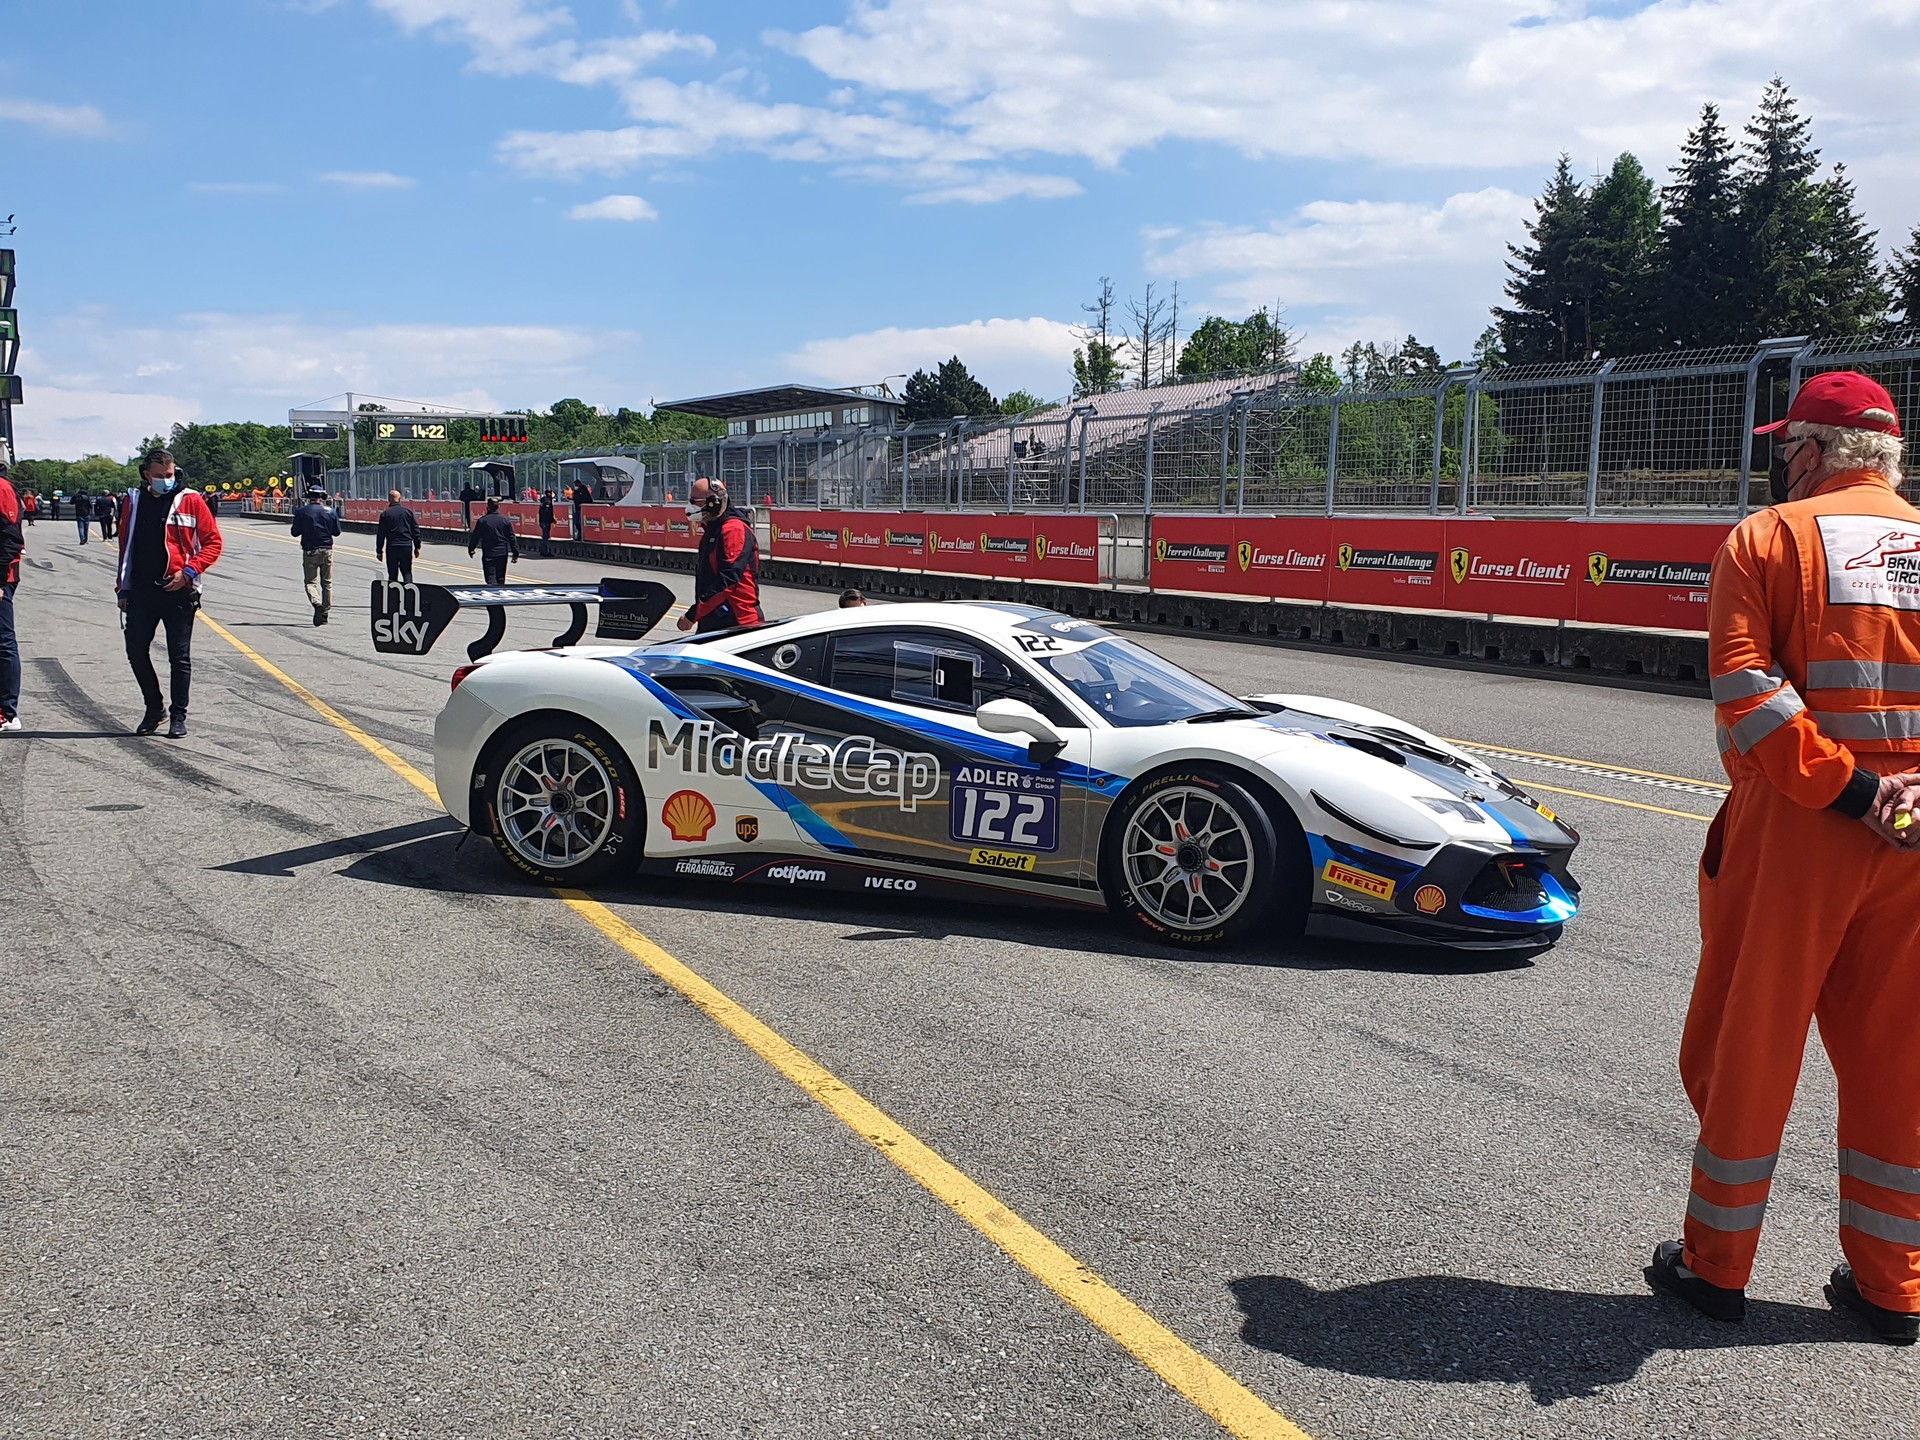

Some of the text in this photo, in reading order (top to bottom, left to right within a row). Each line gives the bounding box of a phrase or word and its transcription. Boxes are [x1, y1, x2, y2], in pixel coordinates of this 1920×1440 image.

[379, 424, 445, 439] SP 14:22
[850, 532, 864, 544] Corse
[937, 536, 976, 551] Corse Clienti
[987, 540, 1027, 552] Ferrari Challenge
[1046, 541, 1096, 557] Corse Clienti
[1167, 544, 1226, 560] Ferrari Challenge
[1252, 548, 1327, 567] Corse Clienti
[1352, 552, 1433, 570] Ferrari Challenge
[1470, 556, 1571, 580] Corse Clienti
[1887, 557, 1920, 571] BRN
[1408, 575, 1432, 585] PIRELLI
[1609, 562, 1711, 585] Ferrari Challeng
[1886, 570, 1920, 584] CIRC
[1851, 581, 1884, 589] CZECH
[1689, 591, 1708, 603] PIRE
[630, 612, 649, 622] Praha
[374, 612, 430, 652] sky
[1011, 634, 1063, 652] 122
[645, 716, 940, 812] MiddleCap
[956, 766, 1019, 788] ADLER
[1141, 774, 1191, 794] PIRELLI
[961, 788, 1045, 845] 122
[737, 823, 757, 840] ups
[496, 836, 540, 876] PIRELLI
[975, 850, 1029, 870] Sabelt
[767, 865, 827, 884] rotiform
[1327, 864, 1389, 895] PIRELLI
[864, 876, 917, 891] IVECO
